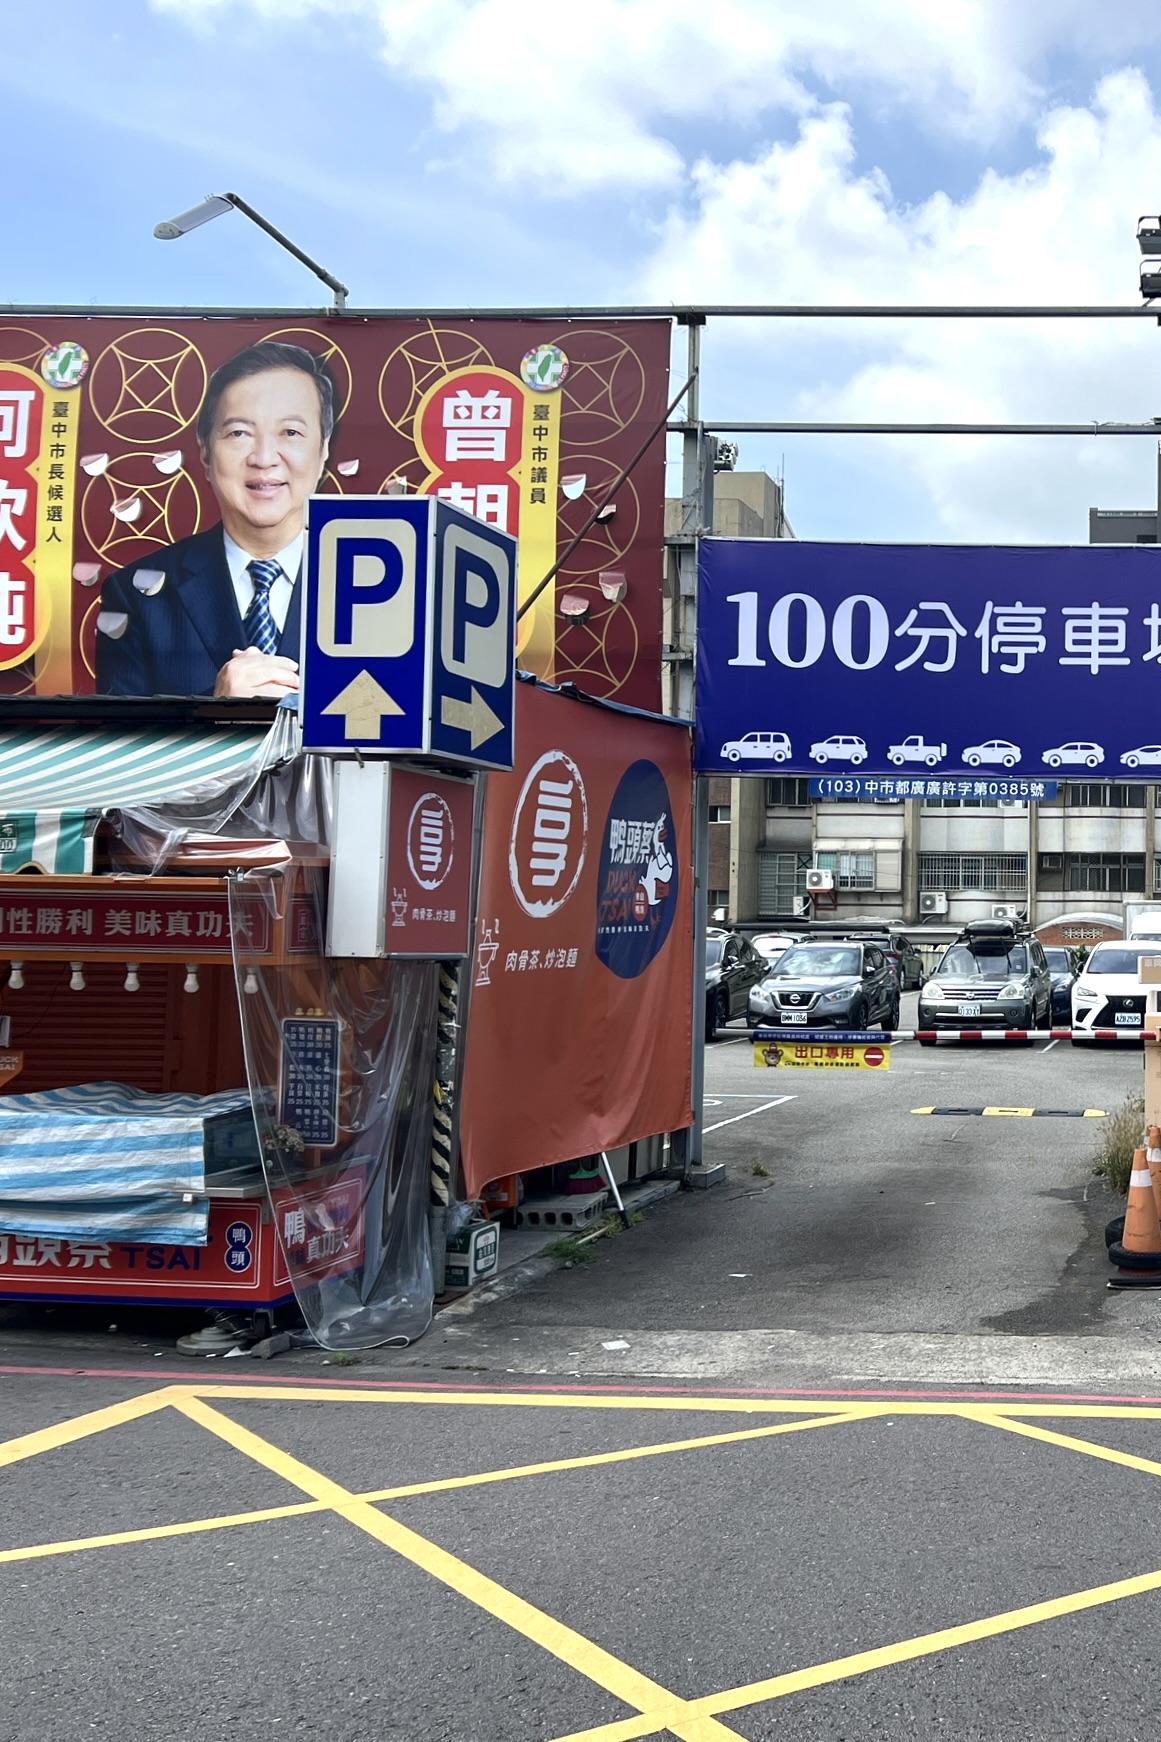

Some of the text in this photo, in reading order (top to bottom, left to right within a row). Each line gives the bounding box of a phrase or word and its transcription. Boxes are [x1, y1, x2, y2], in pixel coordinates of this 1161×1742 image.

[46, 401, 70, 543] 臺中市長候選人
[529, 404, 551, 504] 臺中市議員
[334, 537, 404, 645] P
[452, 545, 501, 665] P
[609, 819, 655, 864] 鴨頭蔡
[0, 907, 254, 937] 性勝利 美味真功夫
[795, 1046, 854, 1059] 出口專用
[232, 1227, 247, 1267] 鴨頭
